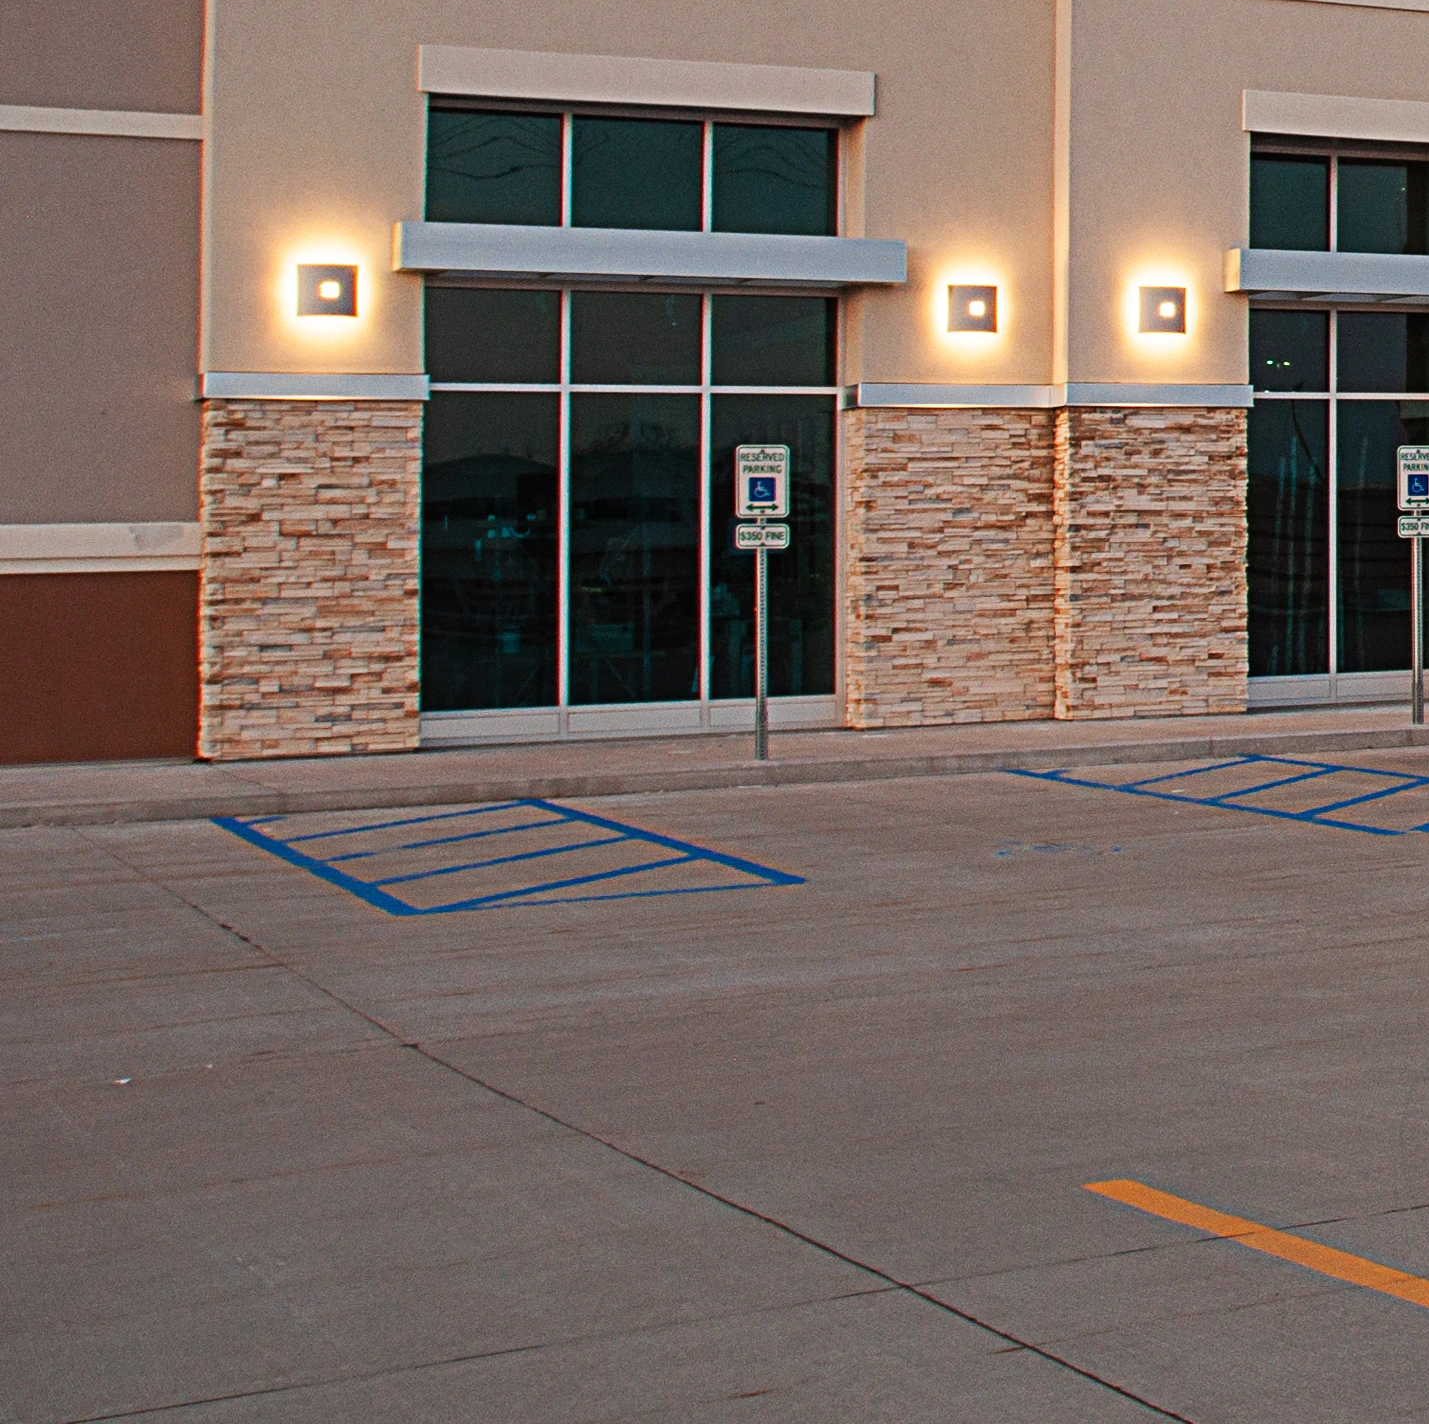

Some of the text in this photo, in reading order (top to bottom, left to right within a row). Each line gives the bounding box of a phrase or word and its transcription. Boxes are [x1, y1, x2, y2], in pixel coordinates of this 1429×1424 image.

[740, 452, 785, 462] RESERVED
[742, 465, 783, 474] PARKING
[1401, 522, 1419, 531] $350
[740, 531, 786, 541] $350 FINE
